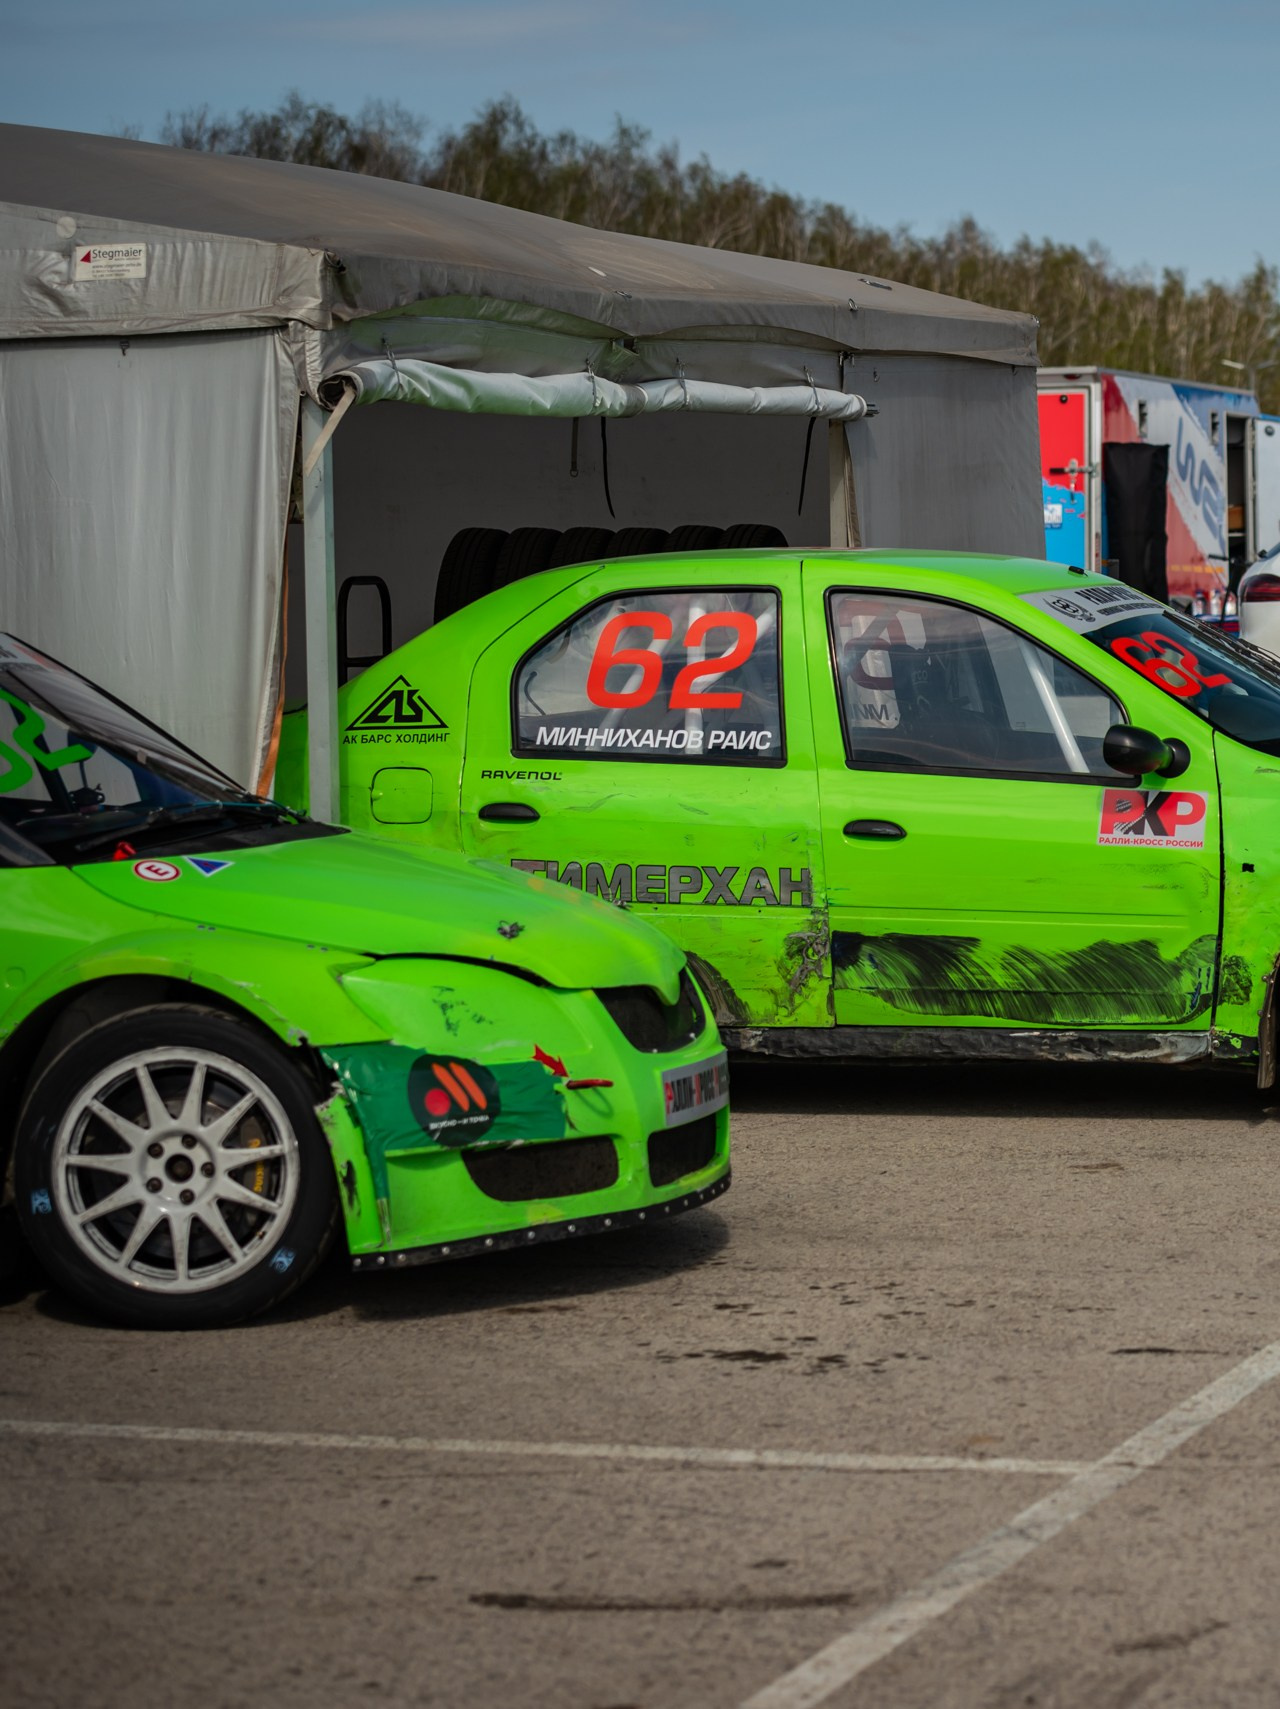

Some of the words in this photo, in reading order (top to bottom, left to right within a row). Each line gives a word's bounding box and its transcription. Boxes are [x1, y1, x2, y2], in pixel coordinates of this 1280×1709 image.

[92, 247, 142, 260] Stegmaier
[586, 611, 757, 708] 62
[1111, 631, 1232, 697] 62
[343, 734, 357, 744] АК
[361, 733, 391, 743] БАРС
[396, 732, 450, 744] ХОЛДИНГ
[535, 727, 704, 749] МИННИХАНОВ
[708, 730, 772, 750] РАИС
[481, 770, 562, 780] RAVENOL
[1098, 837, 1163, 846] РАЛЛИ-КРОСС
[1166, 840, 1203, 848] РОССИИ
